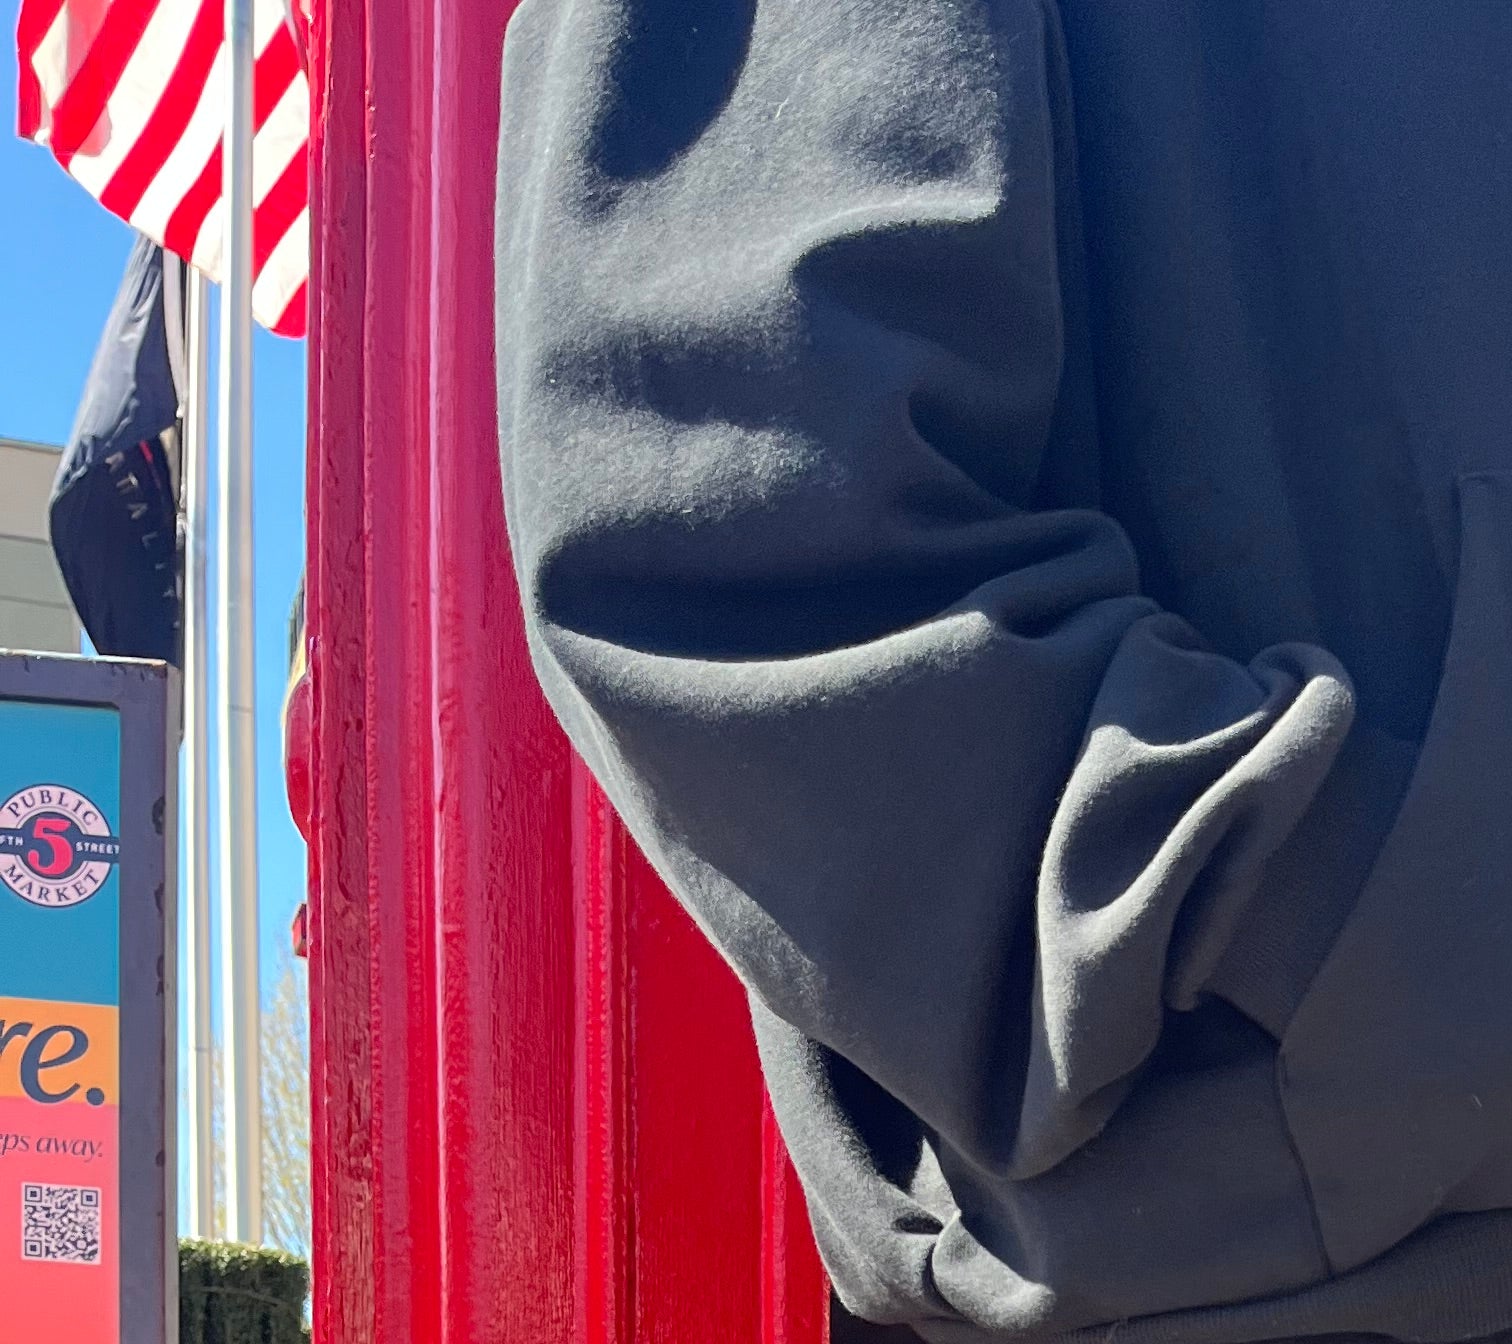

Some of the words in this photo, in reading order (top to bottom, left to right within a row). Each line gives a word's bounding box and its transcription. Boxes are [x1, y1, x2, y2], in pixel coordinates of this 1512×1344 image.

[7, 789, 99, 827] PUBLIC
[27, 817, 74, 876] 5
[75, 841, 120, 854] STREET
[4, 863, 100, 903] MARKET
